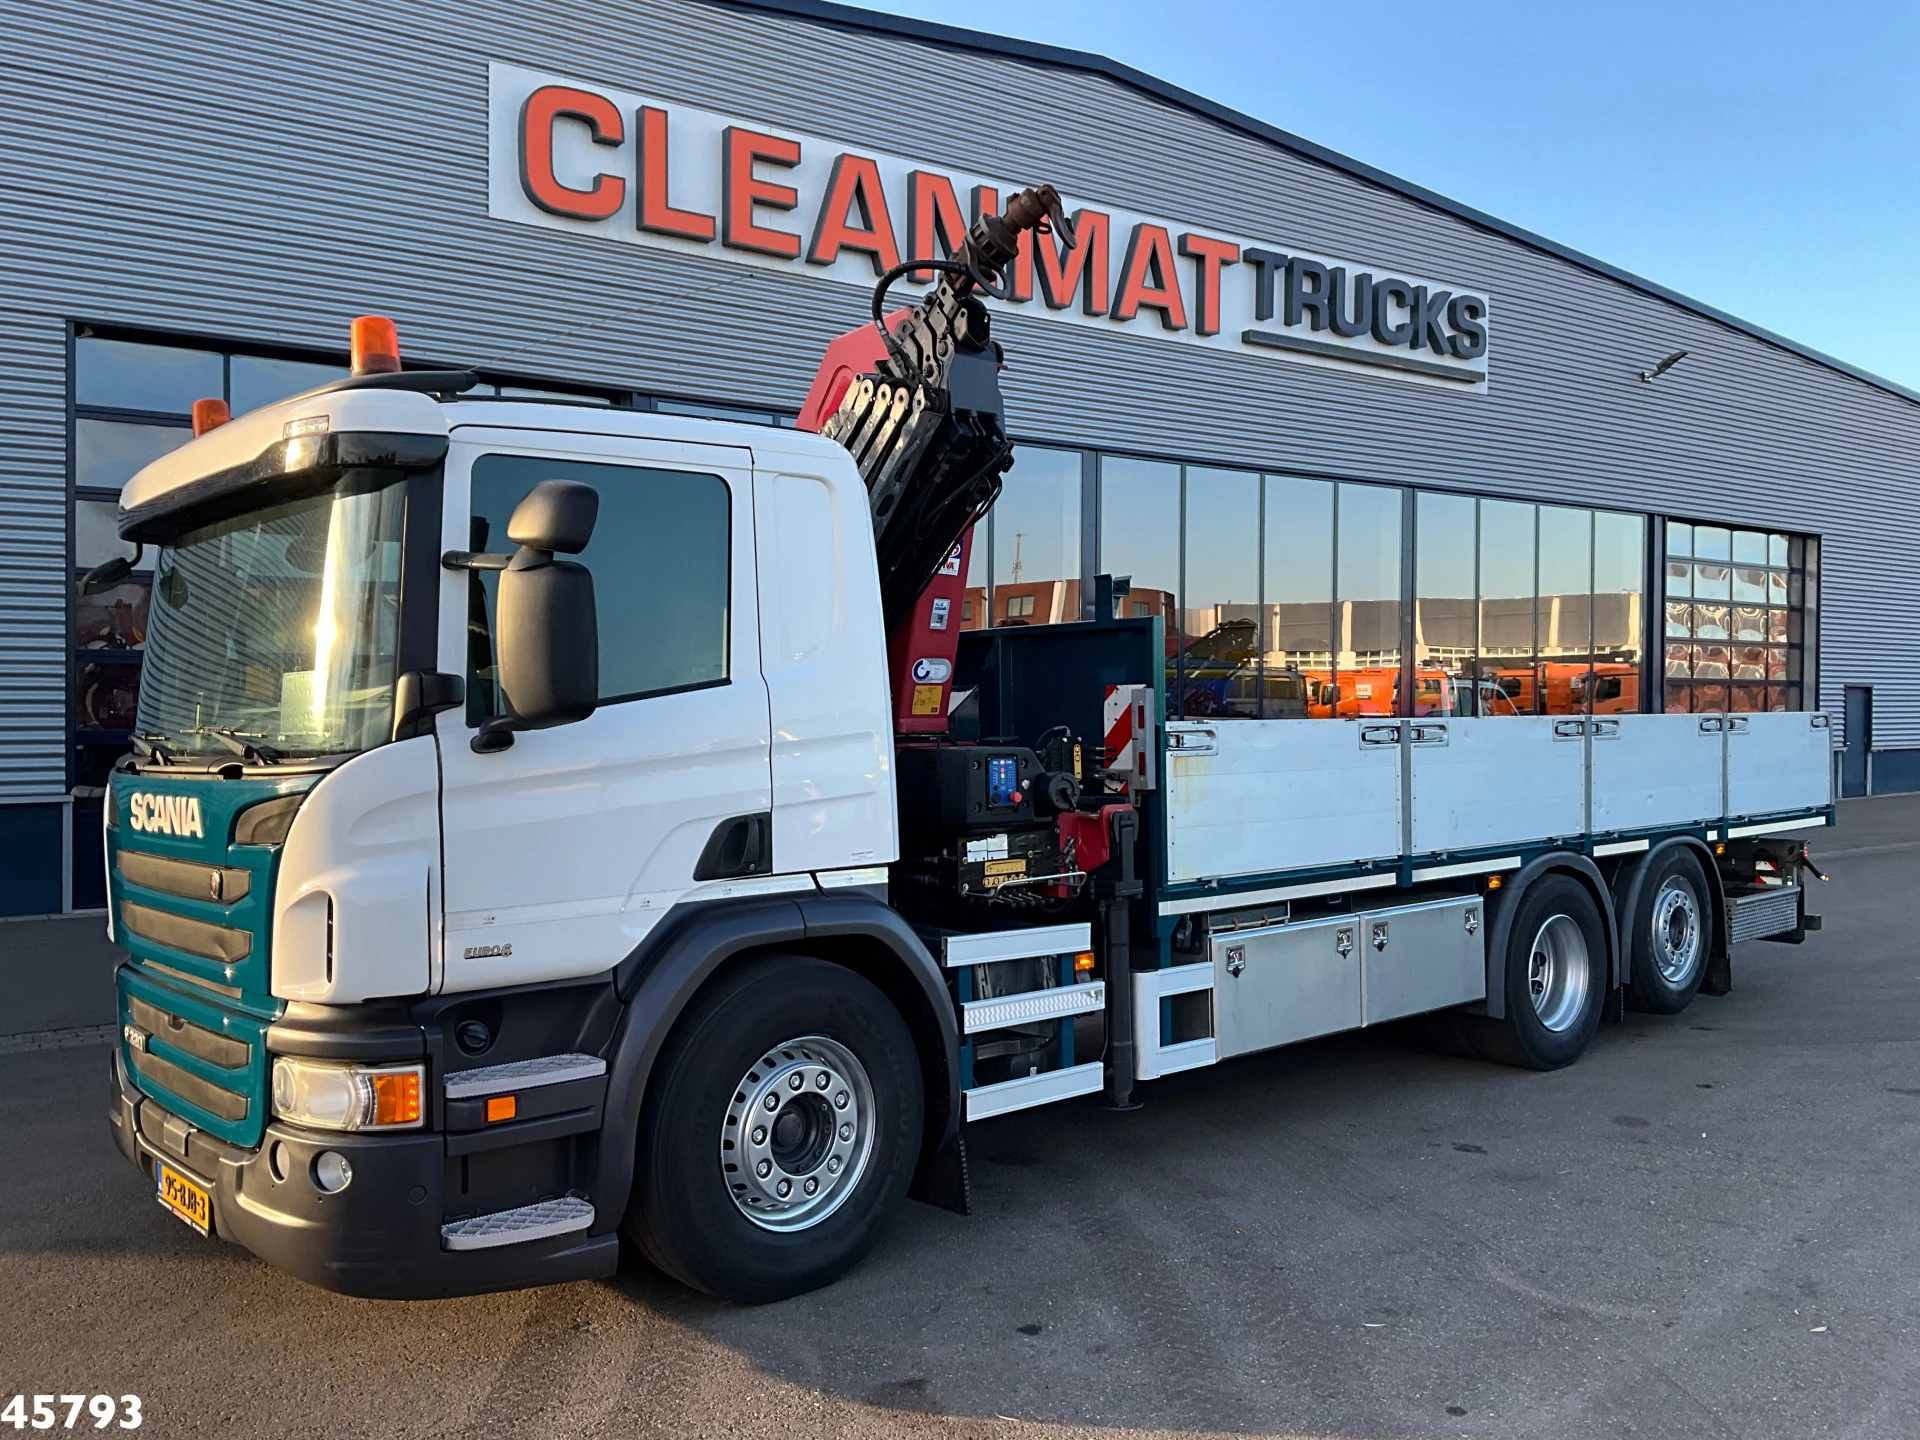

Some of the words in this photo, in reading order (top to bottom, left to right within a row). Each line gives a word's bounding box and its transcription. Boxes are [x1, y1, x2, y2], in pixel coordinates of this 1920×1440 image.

[519, 85, 1240, 336] CLEANMAT
[1243, 247, 1487, 360] TRUCKS
[130, 792, 204, 838] SCANIA
